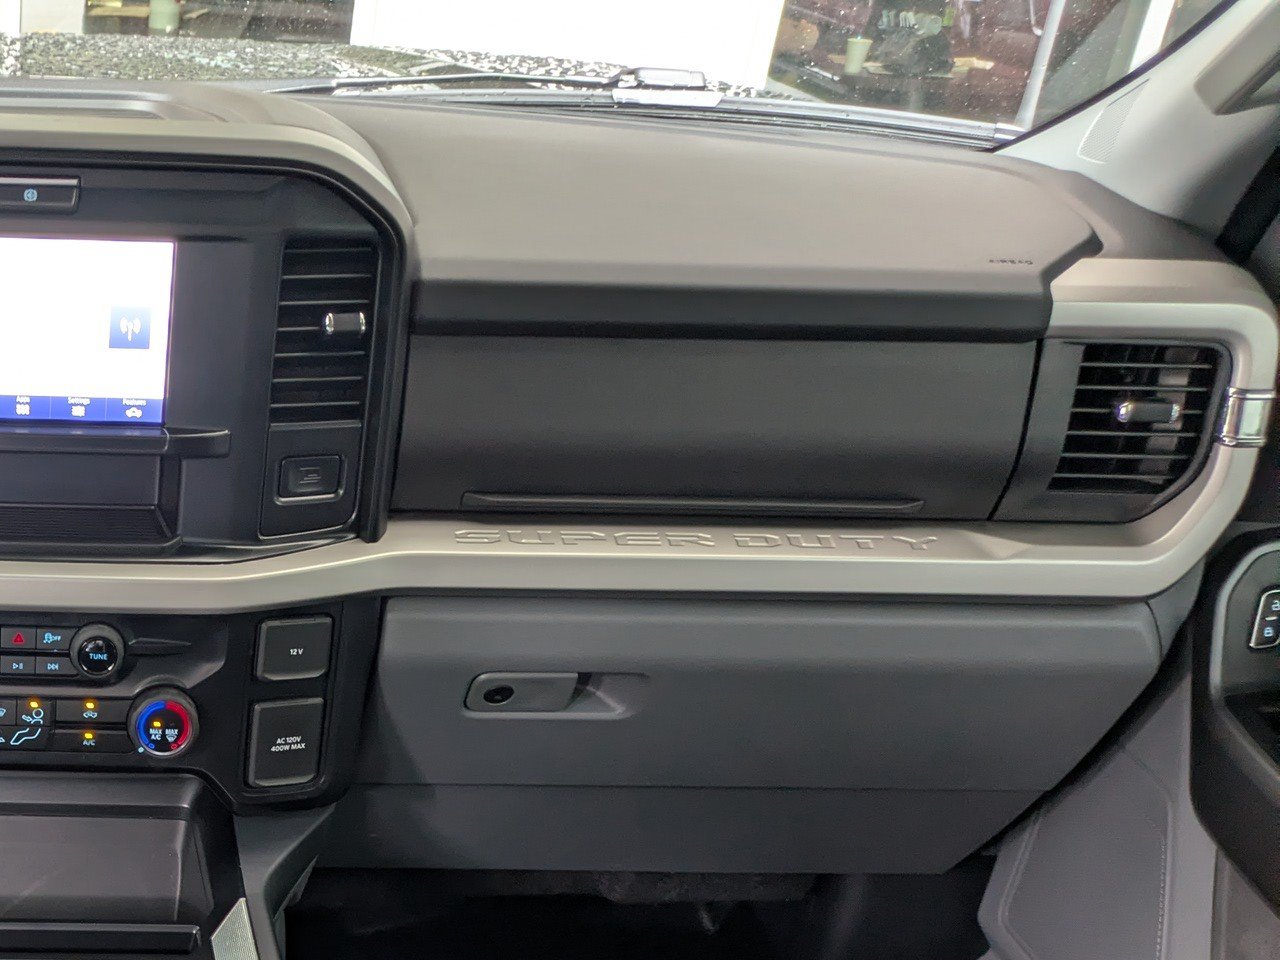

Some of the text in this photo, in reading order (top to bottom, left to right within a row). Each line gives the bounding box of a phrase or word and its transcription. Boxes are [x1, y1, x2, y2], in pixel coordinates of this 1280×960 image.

[454, 529, 939, 551] SUPER DUTY
[89, 653, 108, 661] TUNE
[82, 738, 96, 746] A/C
[286, 736, 302, 744] 120V
[270, 744, 290, 752] 400W
